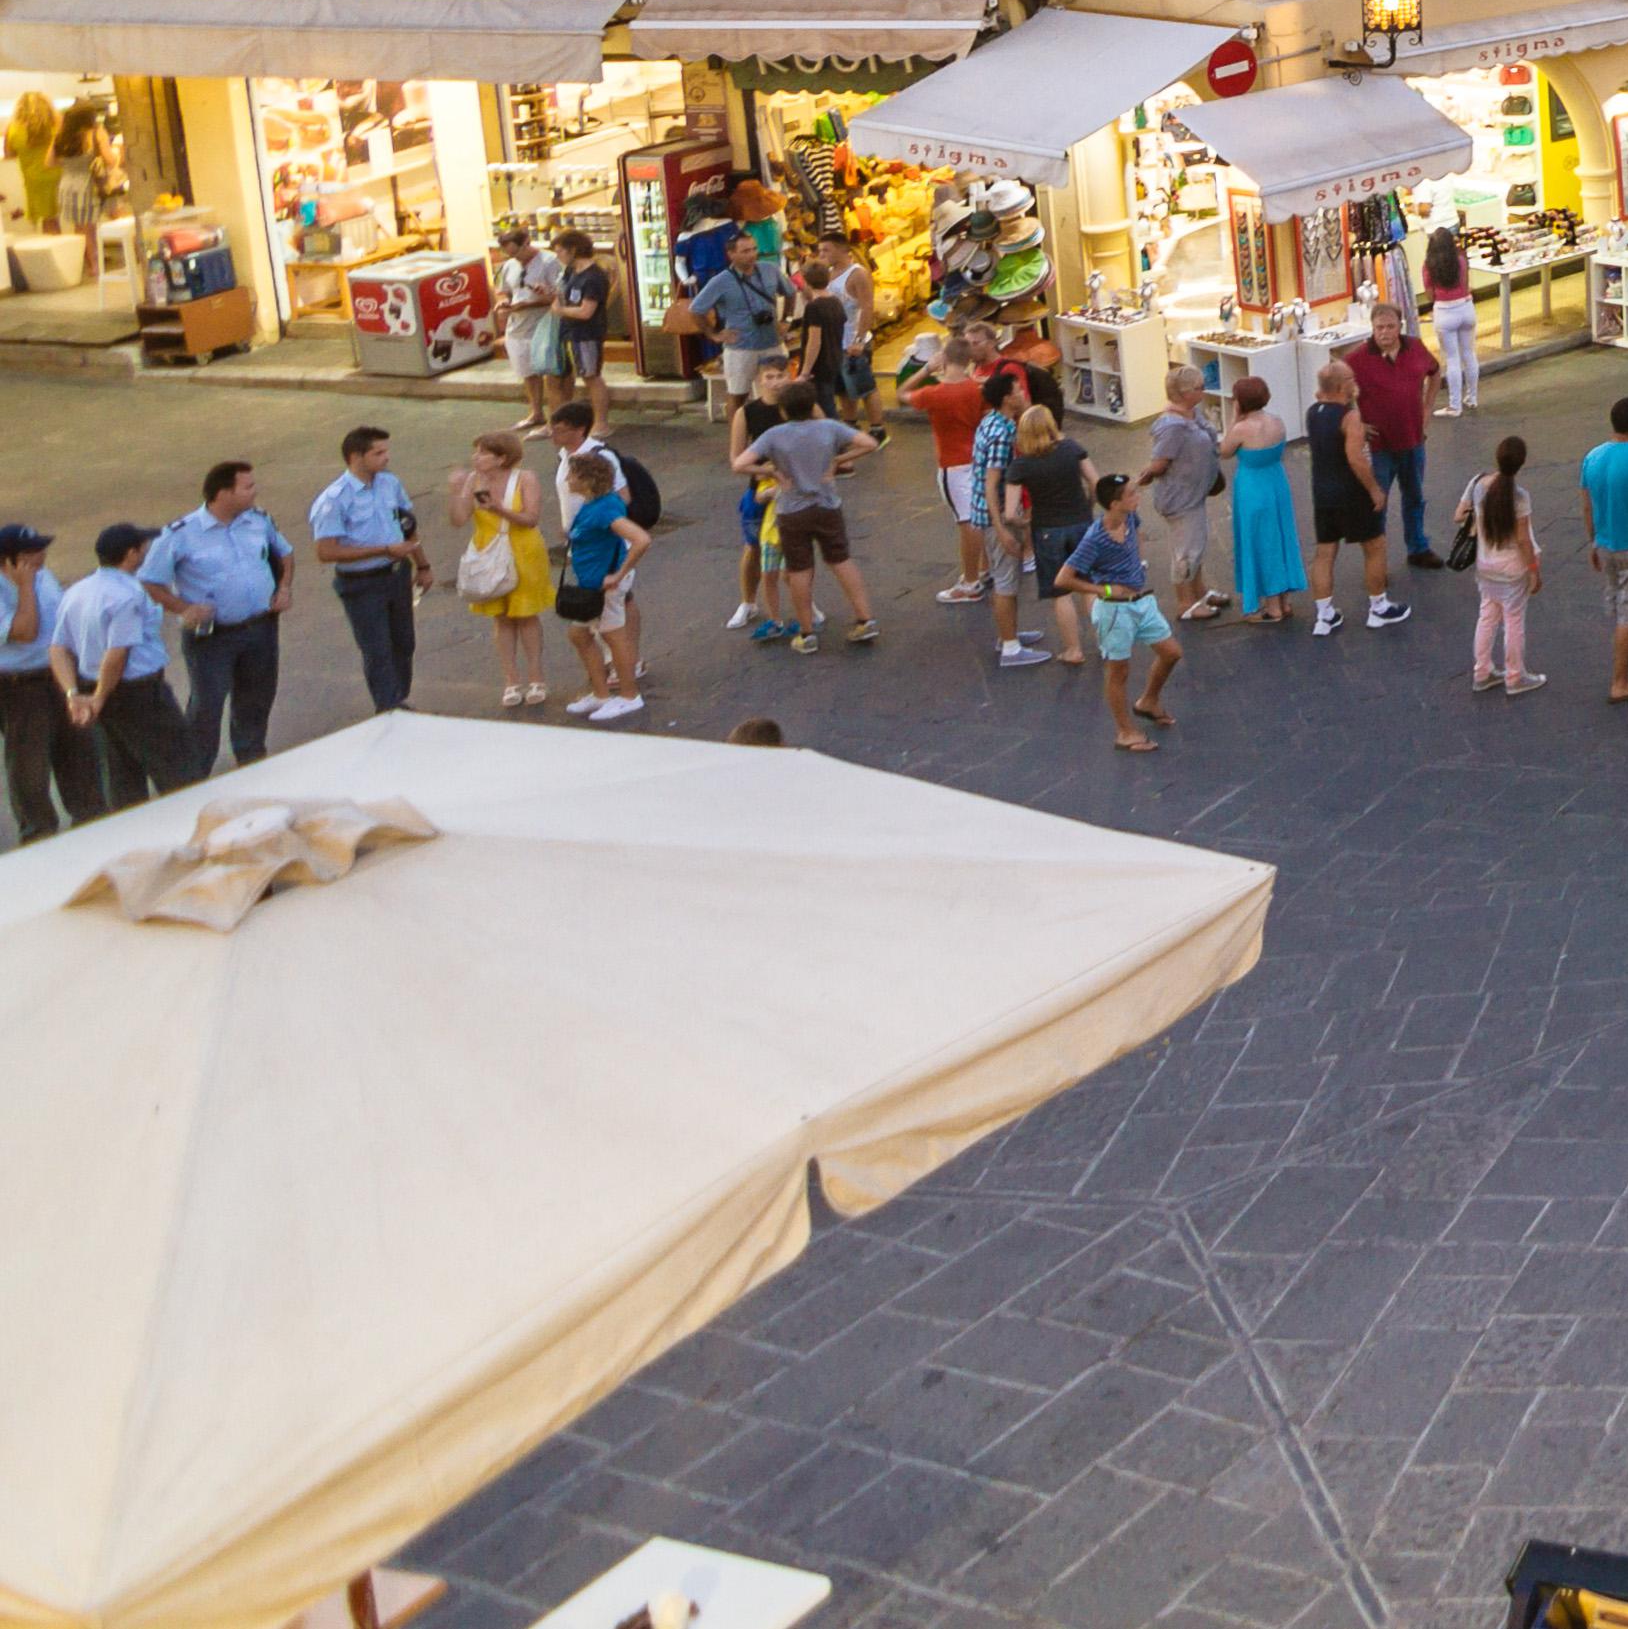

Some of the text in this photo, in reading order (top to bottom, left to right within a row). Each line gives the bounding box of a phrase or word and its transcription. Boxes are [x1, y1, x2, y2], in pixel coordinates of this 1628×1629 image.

[1478, 37, 1565, 62] stigma
[909, 143, 1008, 169] stigma
[1315, 166, 1422, 201] stigma
